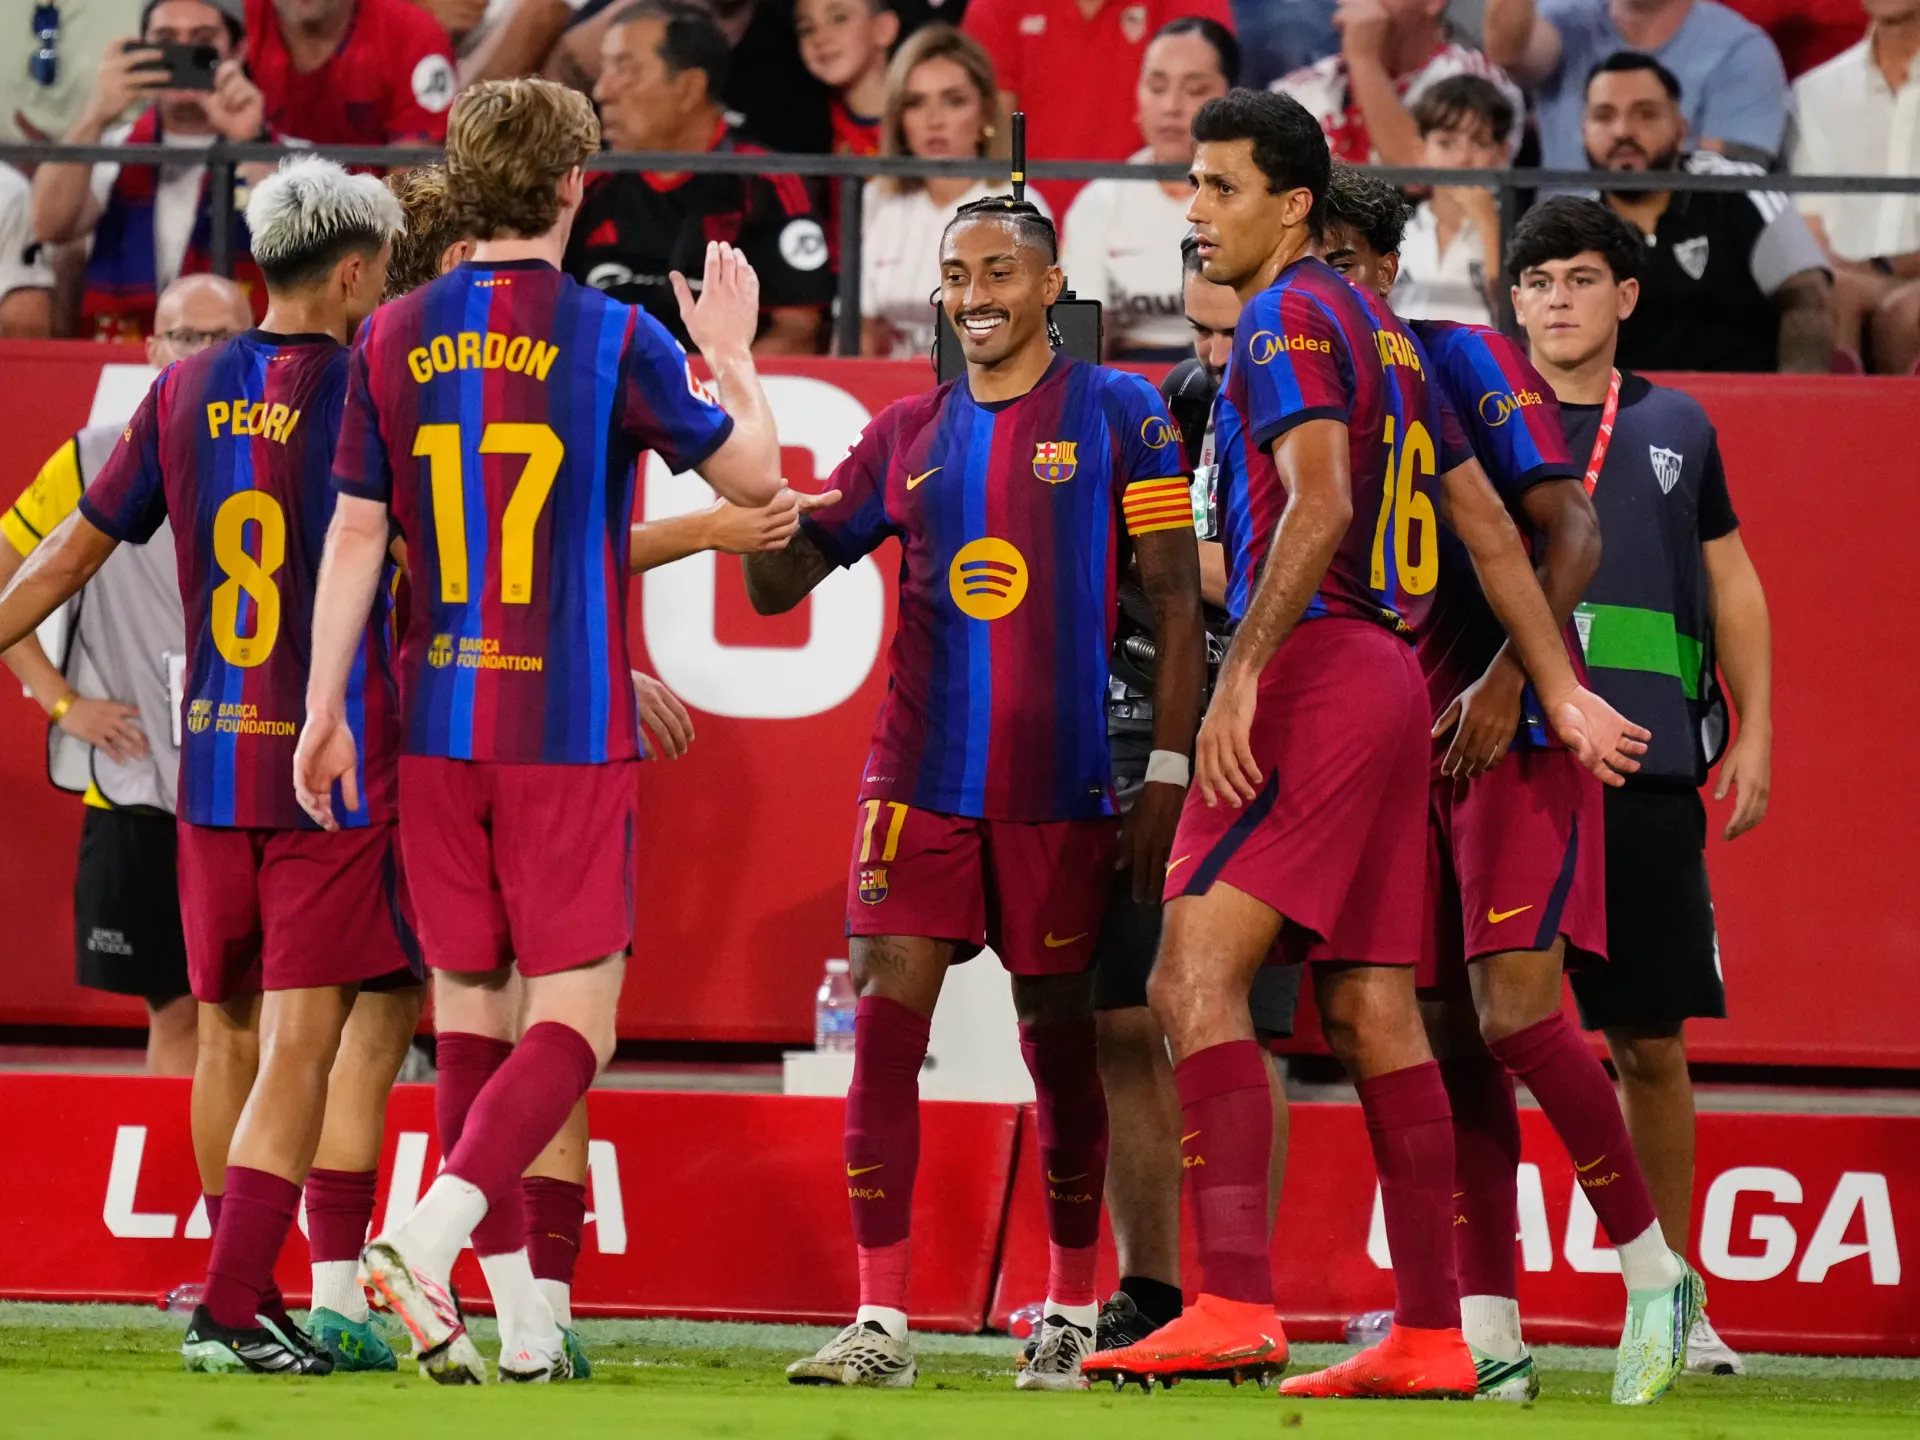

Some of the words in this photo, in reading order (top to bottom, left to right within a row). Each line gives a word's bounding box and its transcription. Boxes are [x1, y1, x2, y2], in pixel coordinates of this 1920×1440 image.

[407, 331, 560, 384] GORDON
[1255, 333, 1331, 363] Midea
[1486, 389, 1542, 424] Midea
[206, 399, 301, 445] PEDRI
[1148, 418, 1184, 448] Mid
[411, 422, 566, 605] 17
[1370, 414, 1439, 596] 16
[210, 490, 286, 669] 8
[459, 637, 500, 655] BARÇA
[456, 654, 543, 672] FOUNDATION
[218, 703, 258, 720] BARÇA
[215, 719, 296, 736] FOUNDATION
[859, 799, 909, 863] 11
[848, 1187, 885, 1201] BARÇA
[1581, 1171, 1621, 1188] BARÇA
